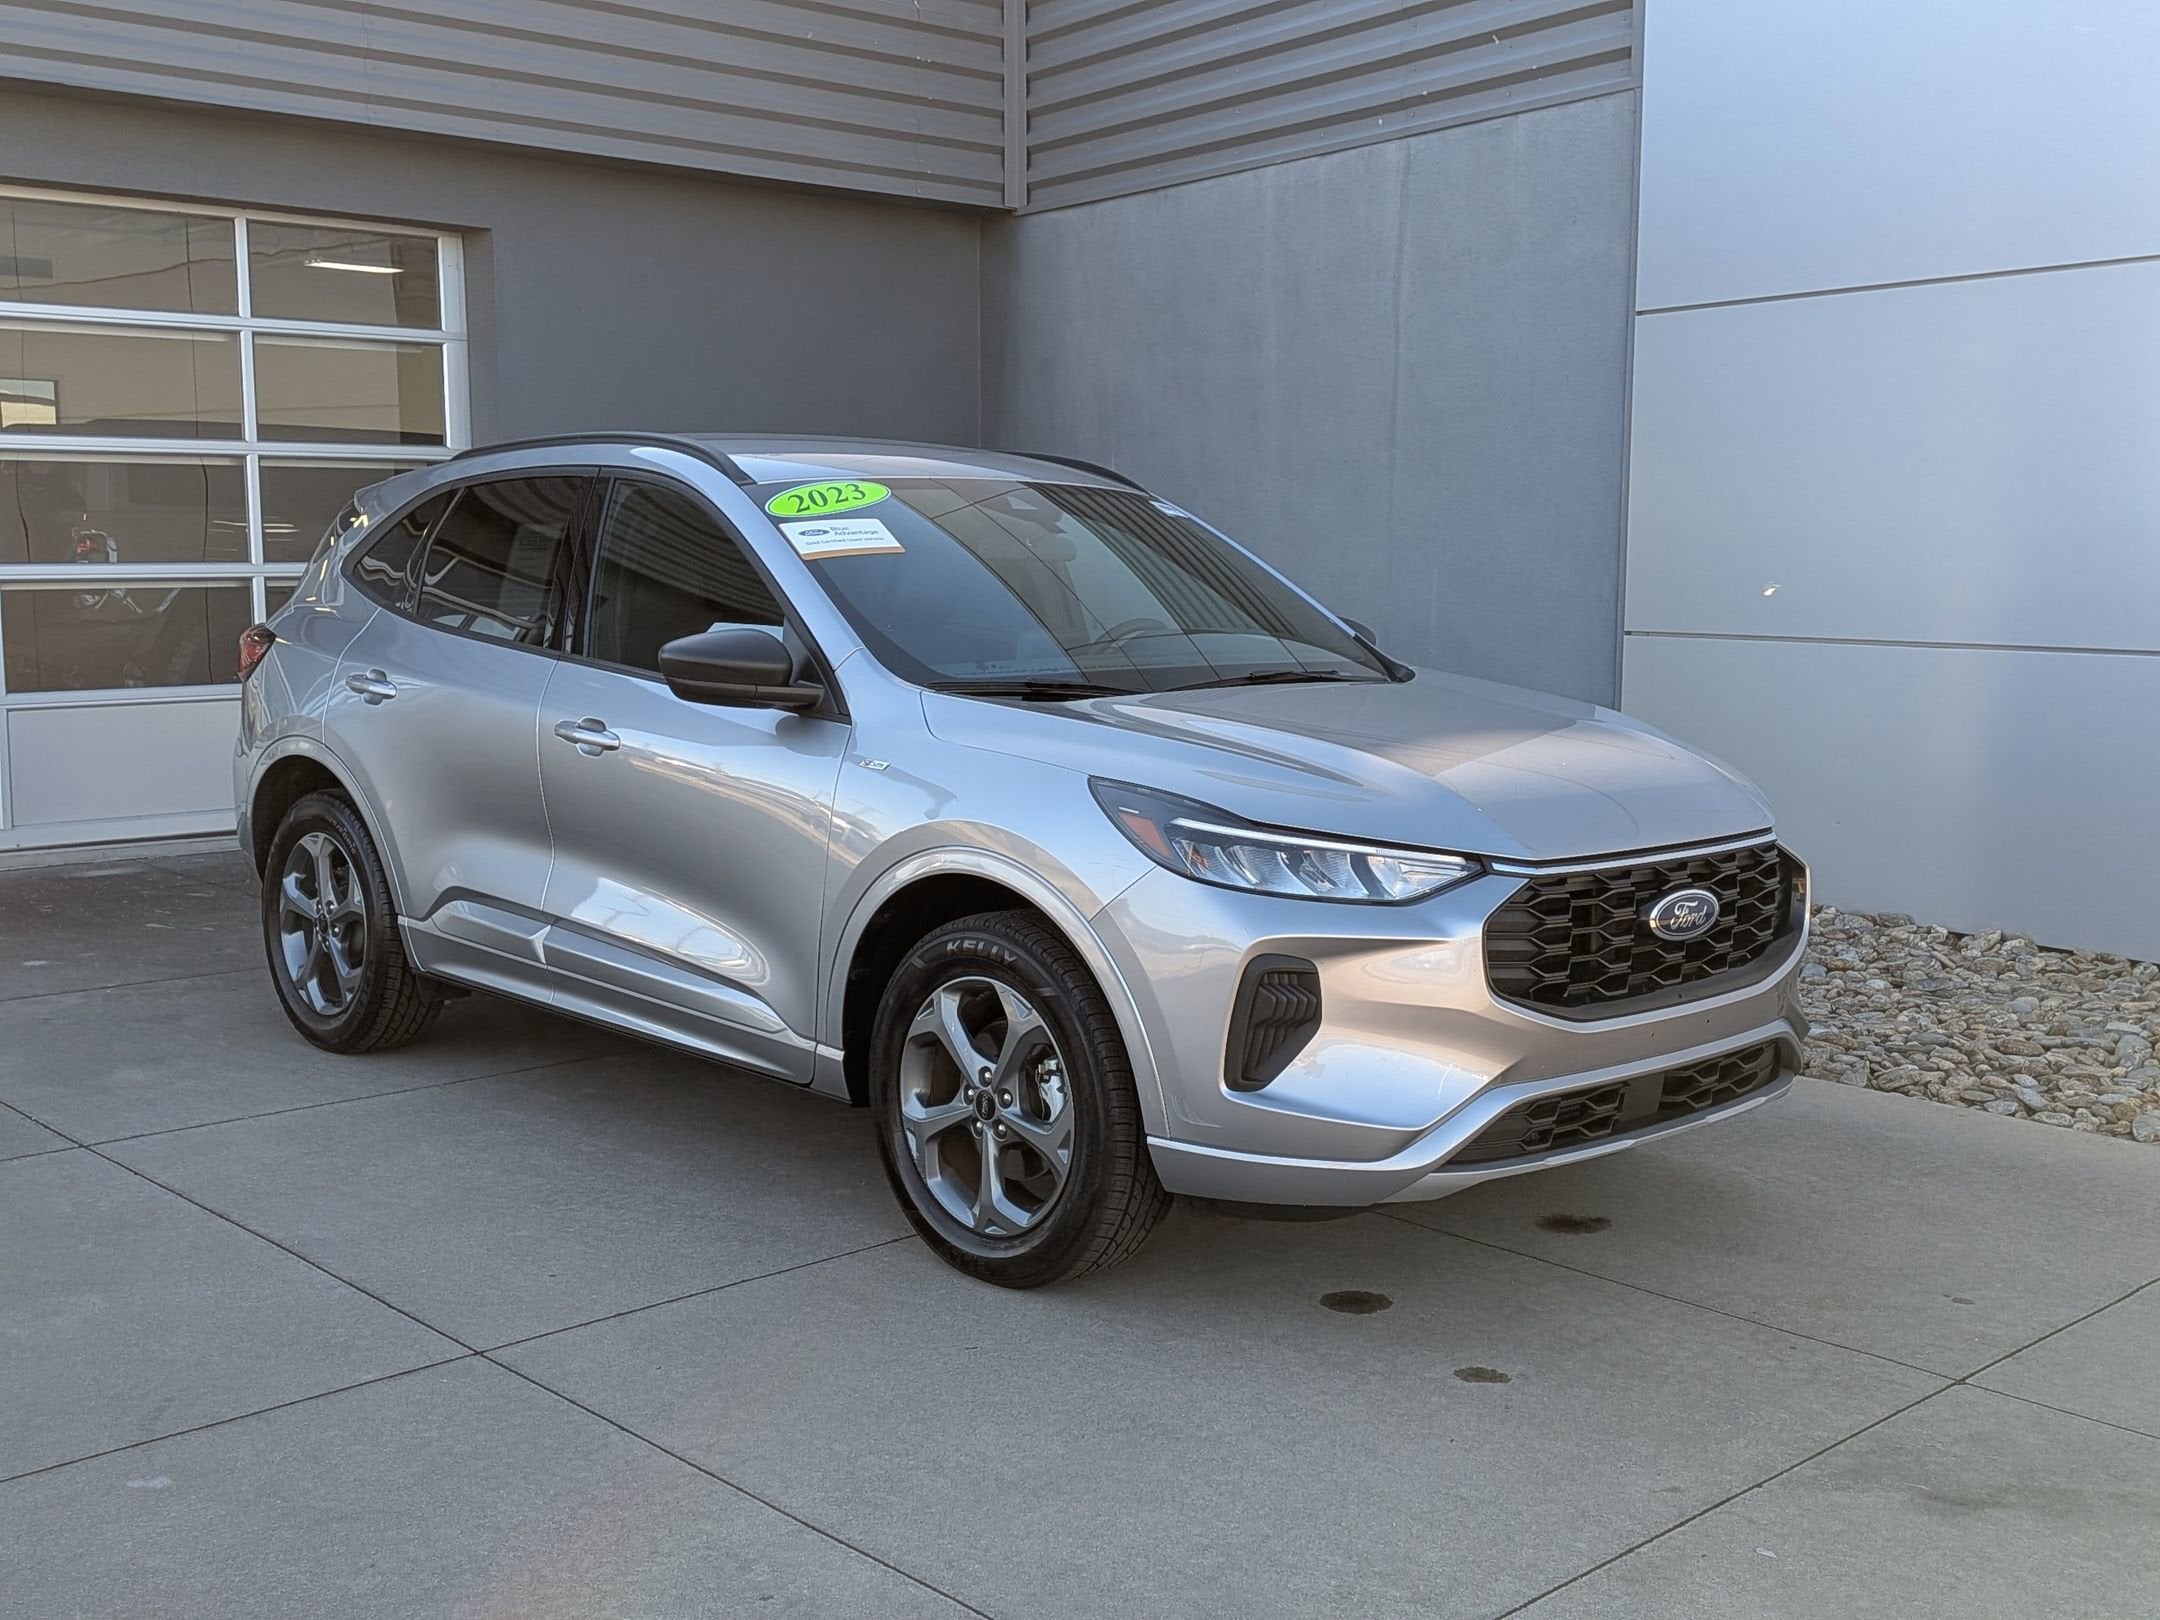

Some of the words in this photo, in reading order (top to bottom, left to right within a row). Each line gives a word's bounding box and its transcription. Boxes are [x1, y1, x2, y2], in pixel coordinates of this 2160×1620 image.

[787, 483, 867, 513] 2023
[834, 529, 879, 537] Advantage
[1670, 900, 1708, 930] Ford
[946, 939, 1019, 965] KELLY
